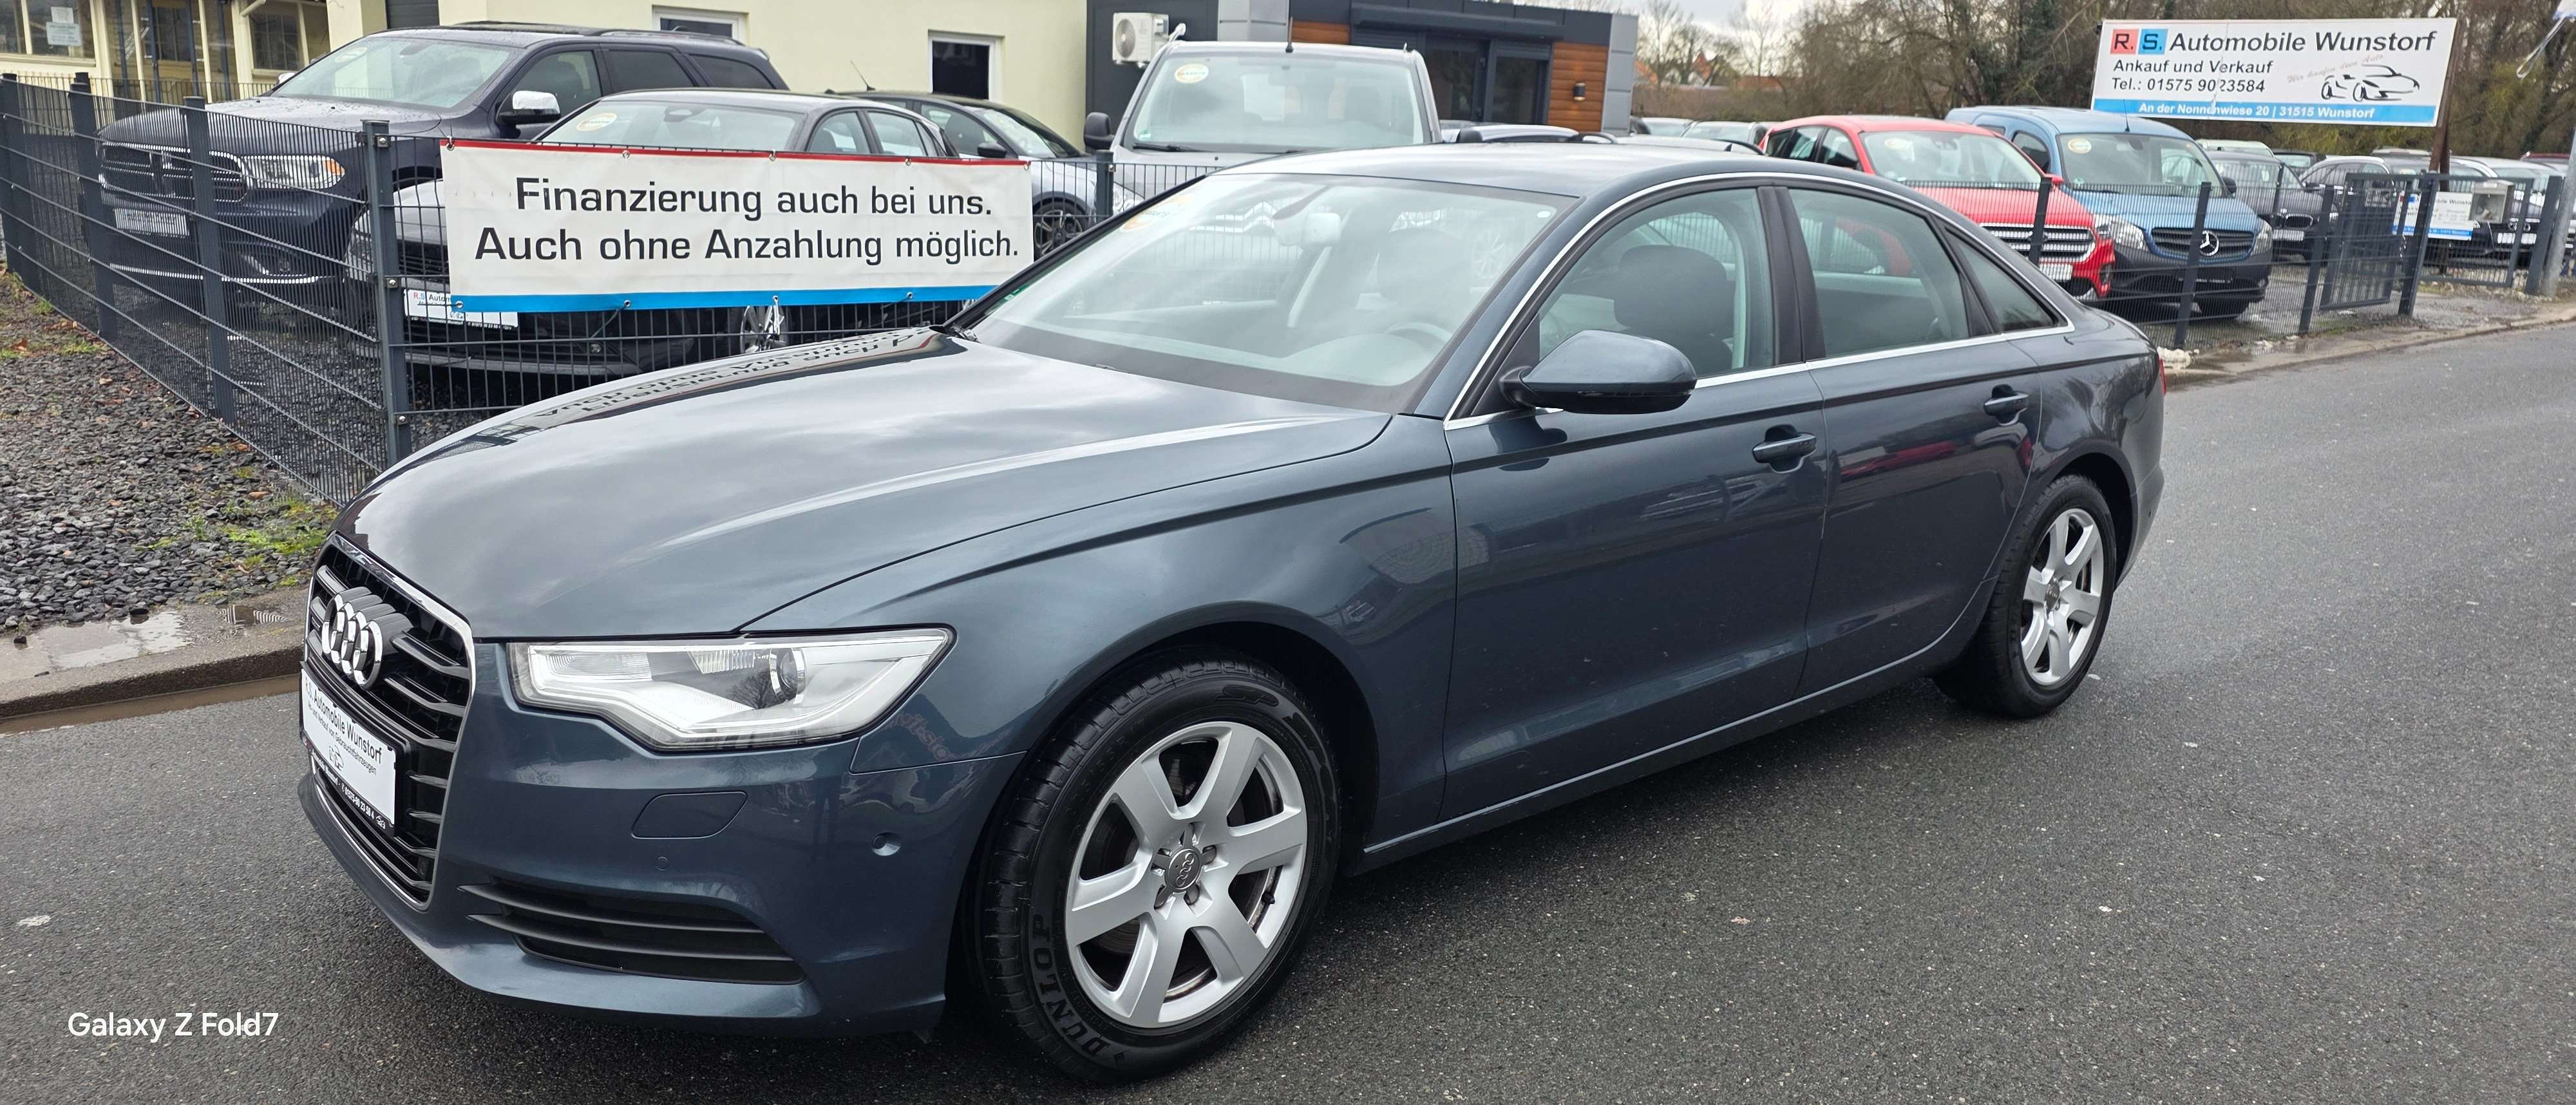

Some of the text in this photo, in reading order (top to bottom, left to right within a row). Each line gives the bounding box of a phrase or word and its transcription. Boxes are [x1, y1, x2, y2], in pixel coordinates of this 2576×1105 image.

[2169, 32, 2306, 52] Automobile
[2315, 31, 2438, 52] Wunstorf
[2113, 59, 2274, 73] Ankauf und Verkauf
[2112, 77, 2142, 90] Tel.:
[2147, 79, 2193, 91] 01575
[2139, 102, 2154, 113] An
[2157, 103, 2176, 113] der
[2255, 105, 2269, 117] 20
[2279, 106, 2314, 117] 31515
[2318, 108, 2375, 118] Wunstorf
[516, 176, 992, 222] Finanzierung auch bei uns.
[475, 227, 1019, 266] Auch ohne Anzahlung möglich.
[314, 688, 345, 735] Automobile
[346, 721, 383, 764] Wunstorf
[1032, 913, 1112, 1057] DUNLOP
